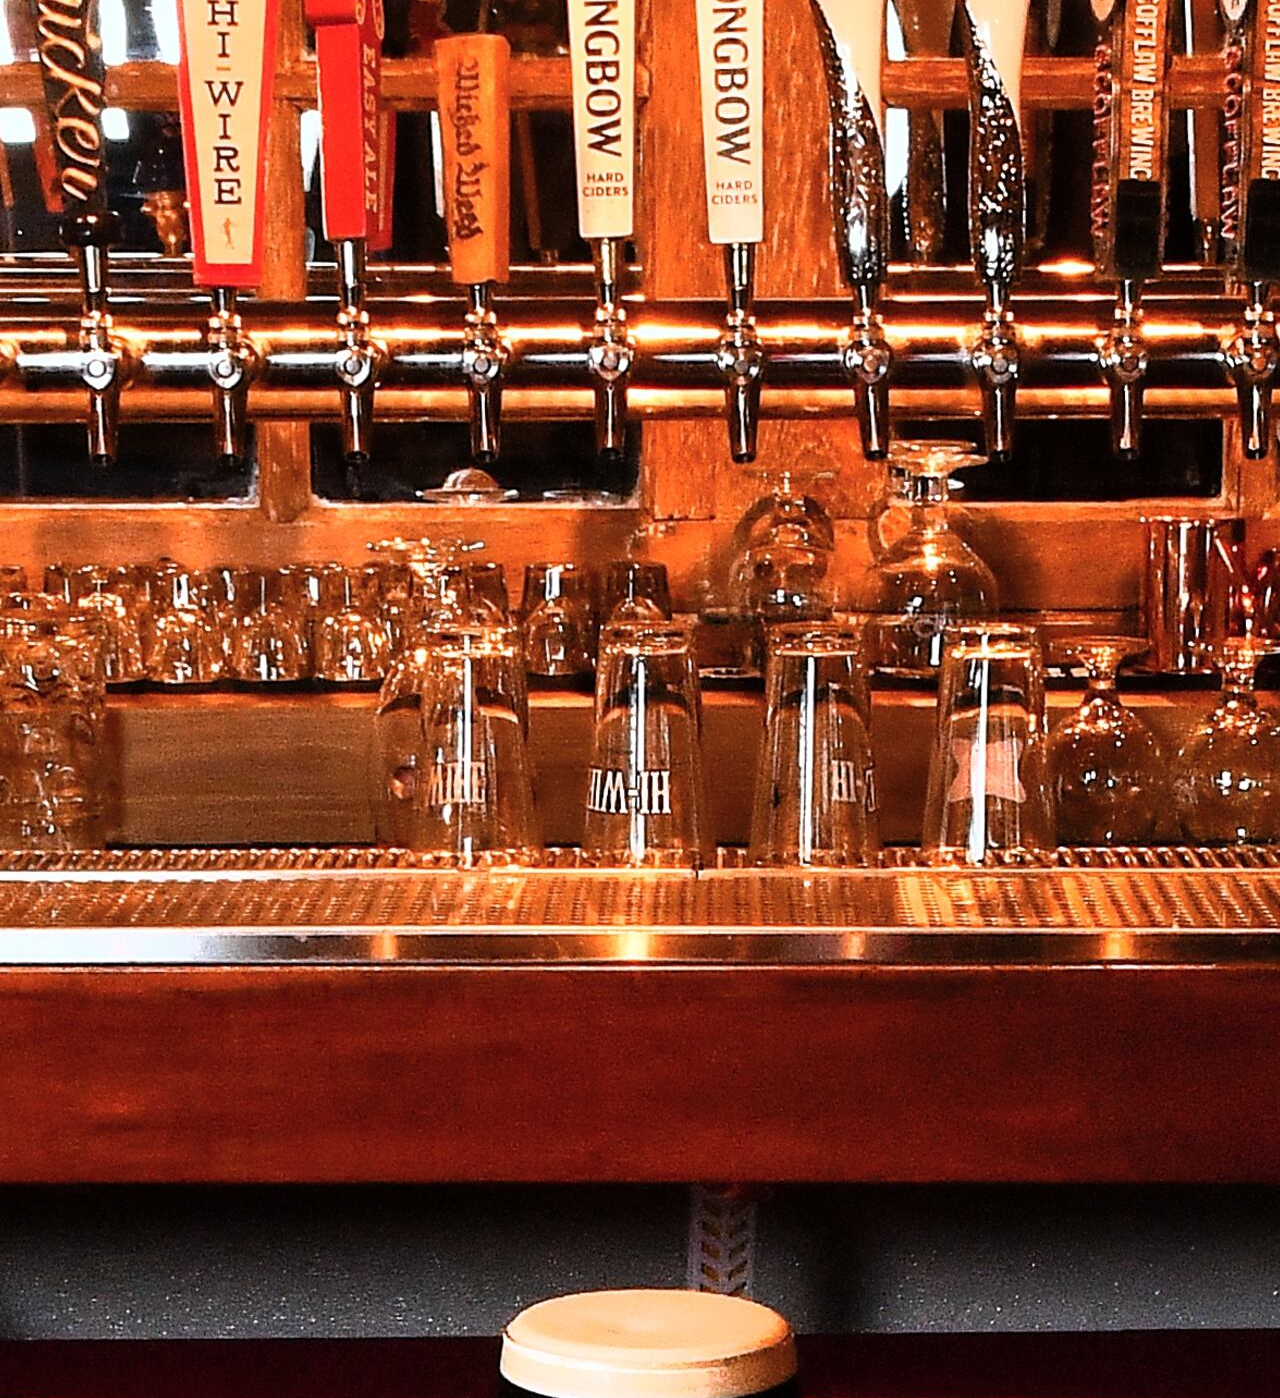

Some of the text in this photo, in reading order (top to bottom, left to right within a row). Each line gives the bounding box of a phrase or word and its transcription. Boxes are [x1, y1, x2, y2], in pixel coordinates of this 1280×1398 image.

[361, 42, 379, 214] EASY ALE
[1129, 89, 1155, 180] BREWING
[586, 173, 624, 183] HARD
[716, 180, 753, 191] HARD
[582, 187, 629, 197] CIDERS
[711, 194, 758, 205] CIDERS
